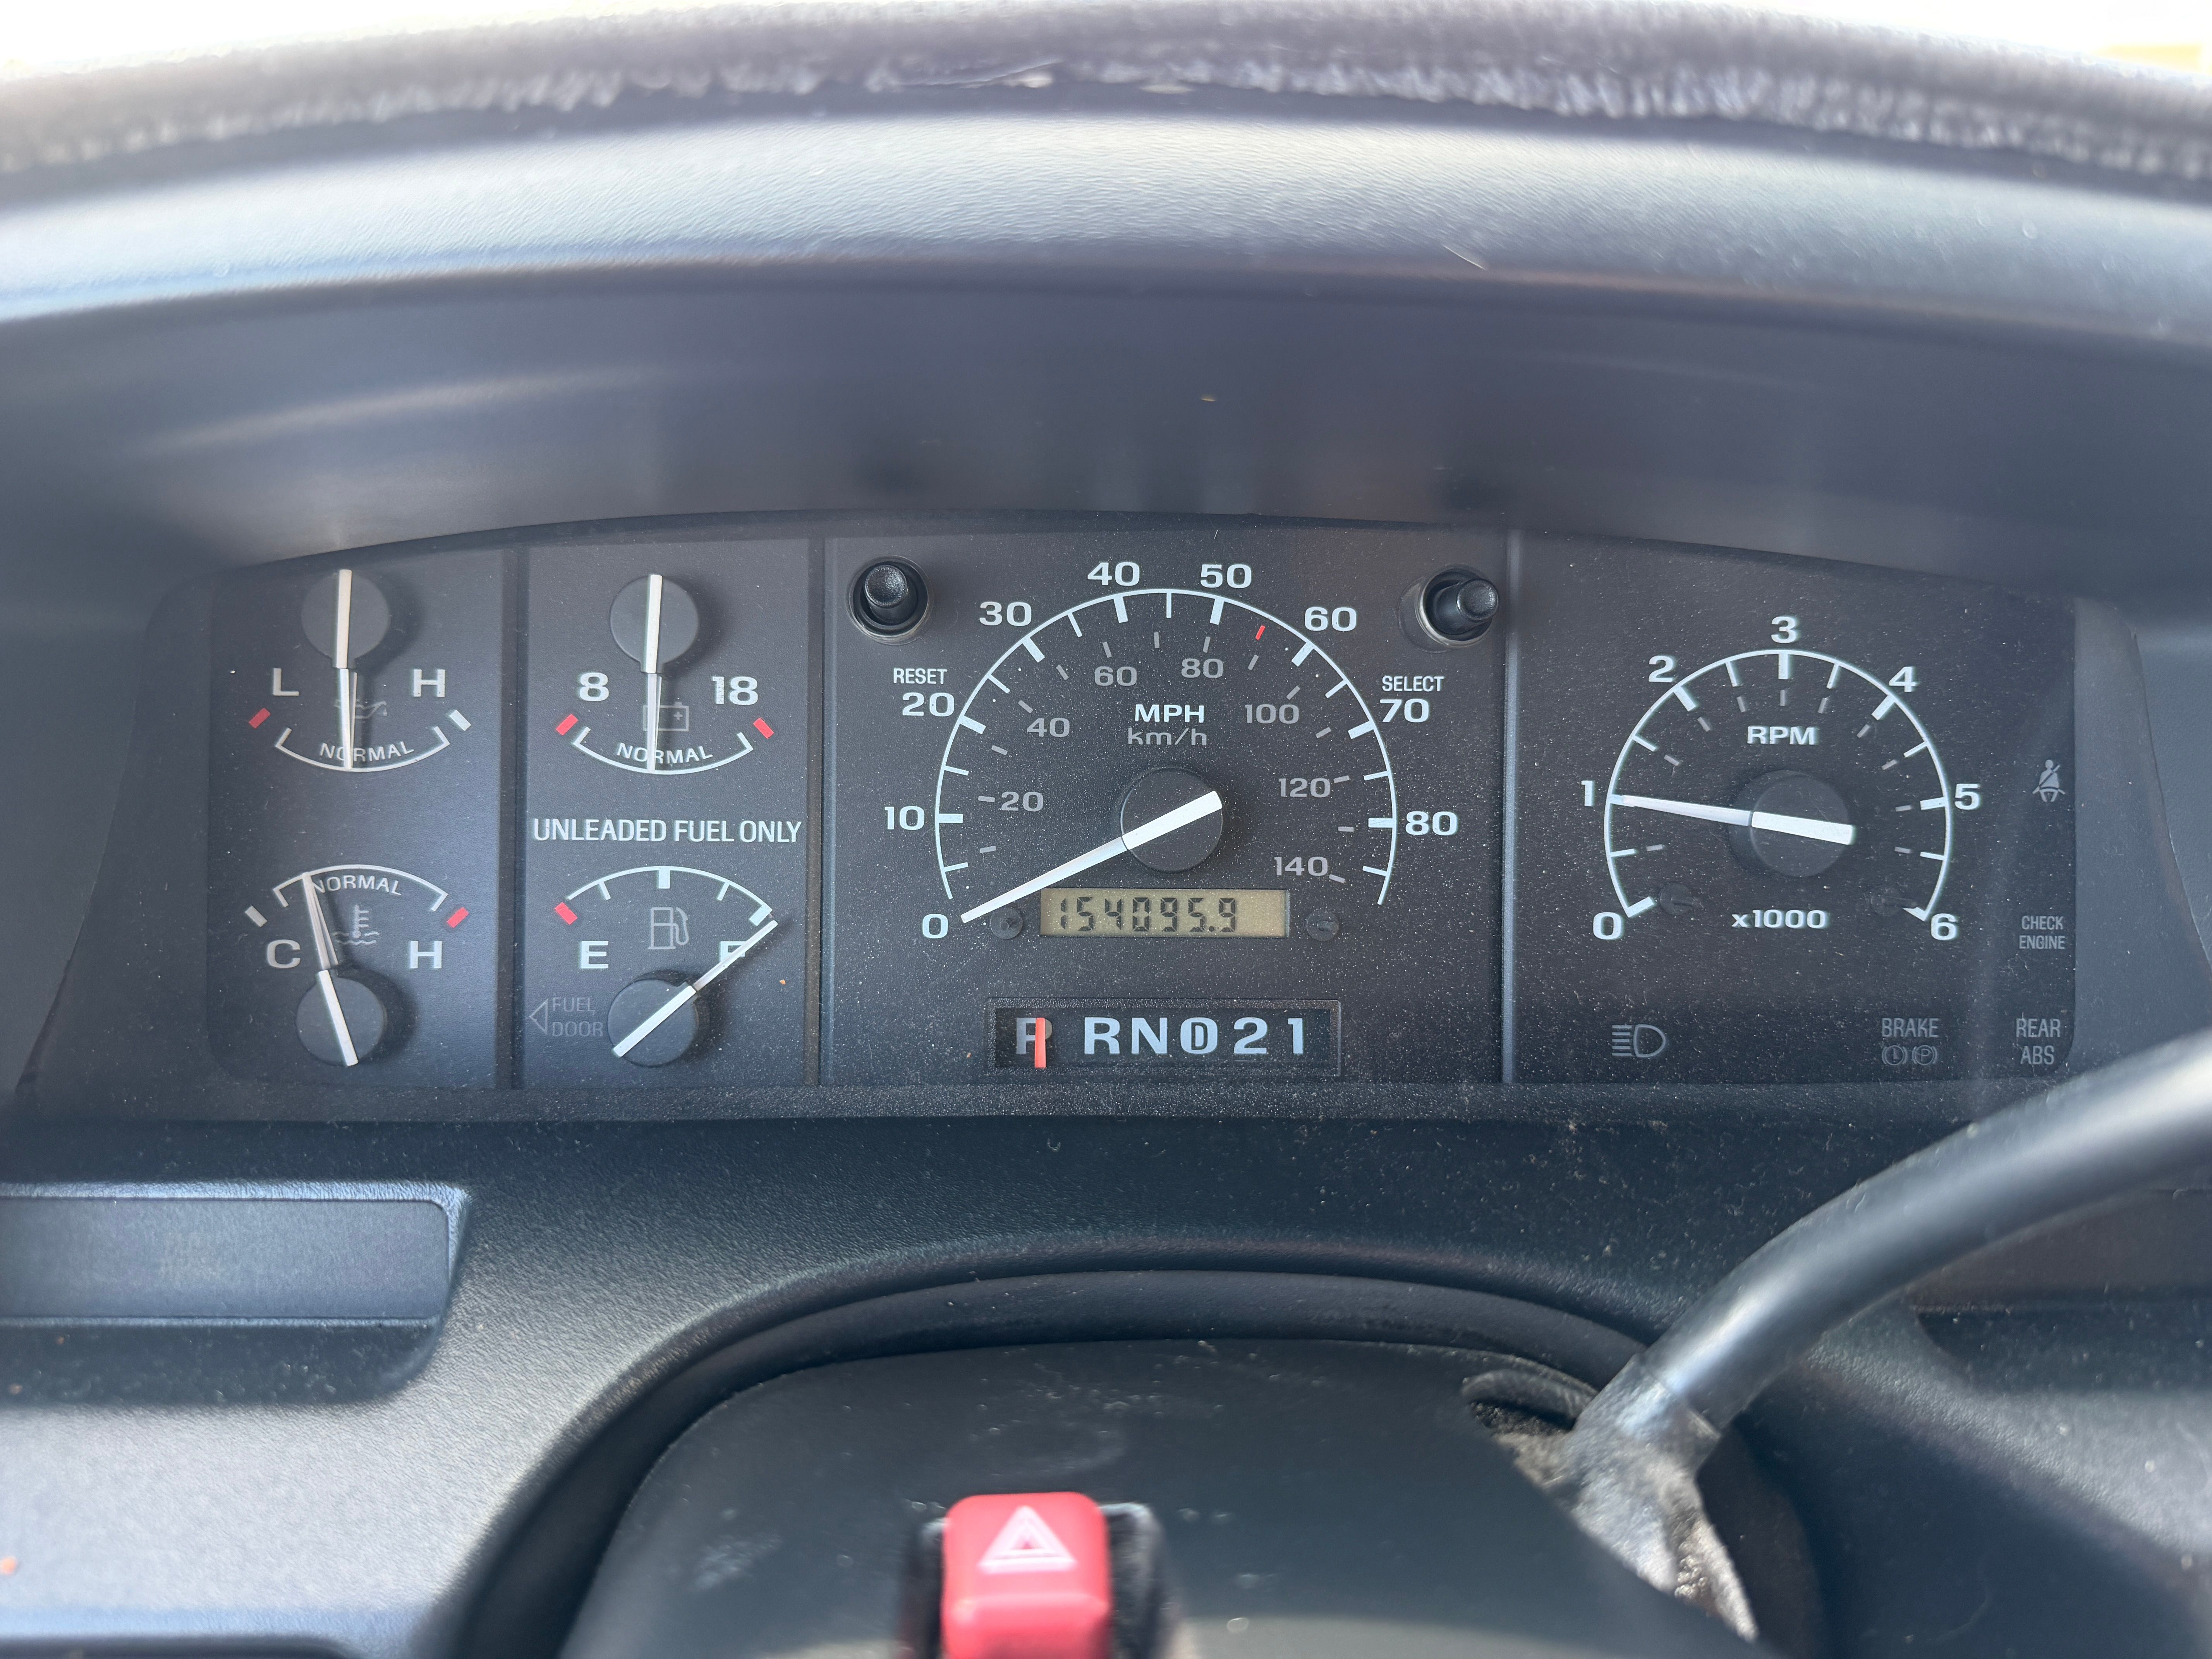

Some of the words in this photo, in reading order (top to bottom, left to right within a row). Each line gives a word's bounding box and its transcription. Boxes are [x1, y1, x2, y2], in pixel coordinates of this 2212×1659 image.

[1088, 562, 1140, 586] 40
[1200, 564, 1252, 588] 50
[979, 601, 1032, 626] 30
[1304, 607, 1357, 631] 60
[1771, 616, 1800, 644] 3
[893, 668, 947, 684] RESET
[1094, 666, 1137, 686] 60
[1181, 658, 1223, 678] 80
[1648, 656, 1676, 683] 2
[1889, 667, 1917, 692] 4
[273, 668, 299, 696] L
[413, 669, 445, 697] H
[579, 672, 609, 701] 8
[712, 676, 758, 705] 18
[1382, 676, 1444, 692] SELECT
[902, 692, 954, 717] 20
[1134, 704, 1204, 723] MPH
[1245, 704, 1299, 724] 100
[1380, 699, 1429, 723] 70
[1027, 718, 1070, 737] 40
[1128, 728, 1207, 746] km/h
[1747, 726, 1819, 745] RPM
[1278, 778, 1331, 798] 120
[1580, 780, 1595, 806] 1
[1954, 783, 1982, 810] 5
[1001, 792, 1044, 812] 20
[534, 818, 666, 841] UNLEADED
[675, 820, 734, 842] FUEL
[739, 821, 802, 842] ONLY
[884, 806, 925, 830] 10
[1405, 811, 1458, 835] 80
[1274, 857, 1328, 876] 140
[311, 875, 402, 896] NORMAL
[922, 914, 948, 939] 0
[1060, 897, 1236, 932] 154095.9
[1592, 912, 1623, 940] 0
[1731, 909, 1829, 929] x1000
[2021, 916, 2064, 930] CHECK
[1930, 914, 1959, 941] 6
[266, 939, 301, 968] C
[410, 941, 443, 969] H
[580, 941, 609, 969] E
[2019, 936, 2066, 950] ENGINE
[553, 998, 595, 1012] FUEL
[551, 1021, 603, 1037] DOOR
[1882, 1018, 1939, 1037] BRAKE
[2016, 1019, 2060, 1037] REAR
[2020, 1046, 2054, 1064] ABS
